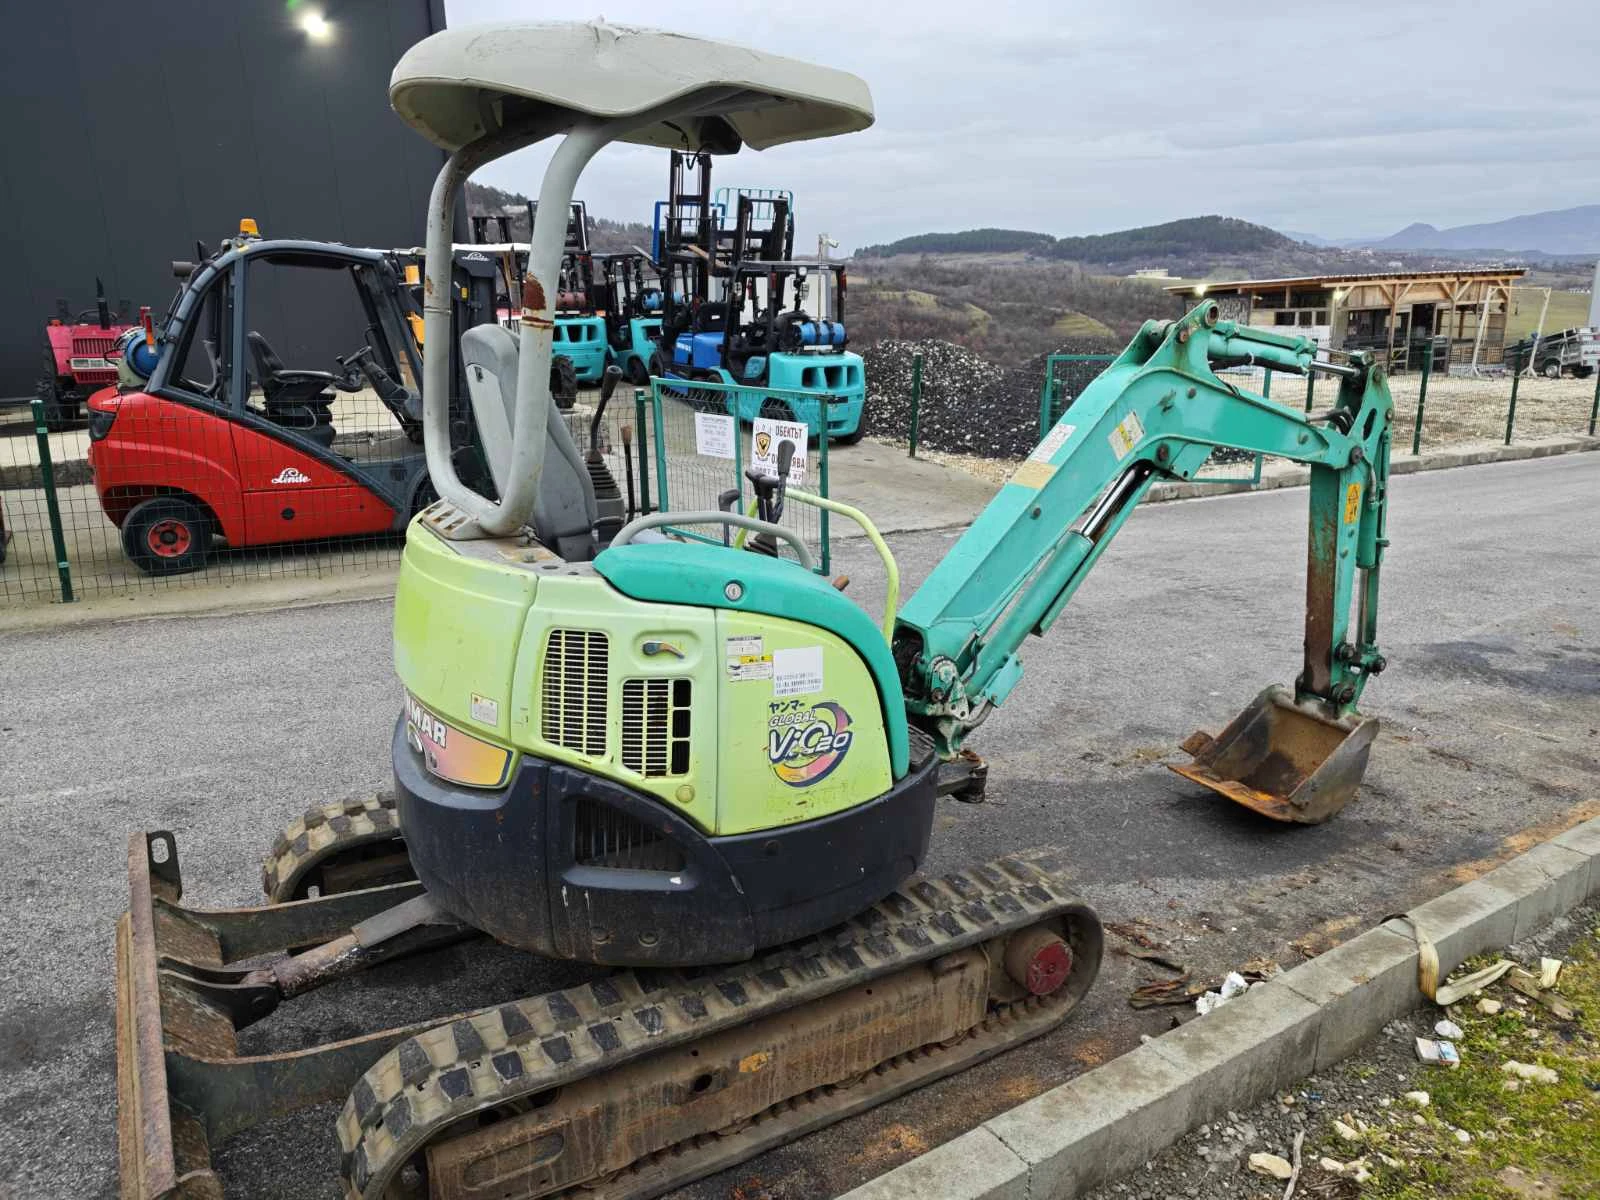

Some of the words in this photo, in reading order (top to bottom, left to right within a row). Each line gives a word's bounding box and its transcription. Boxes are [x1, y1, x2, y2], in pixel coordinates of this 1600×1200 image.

[775, 424, 803, 440] ОБЕКТЪТ
[271, 467, 311, 484] Linde
[769, 700, 805, 713] ヤンマー
[769, 710, 817, 726] GLOBAL
